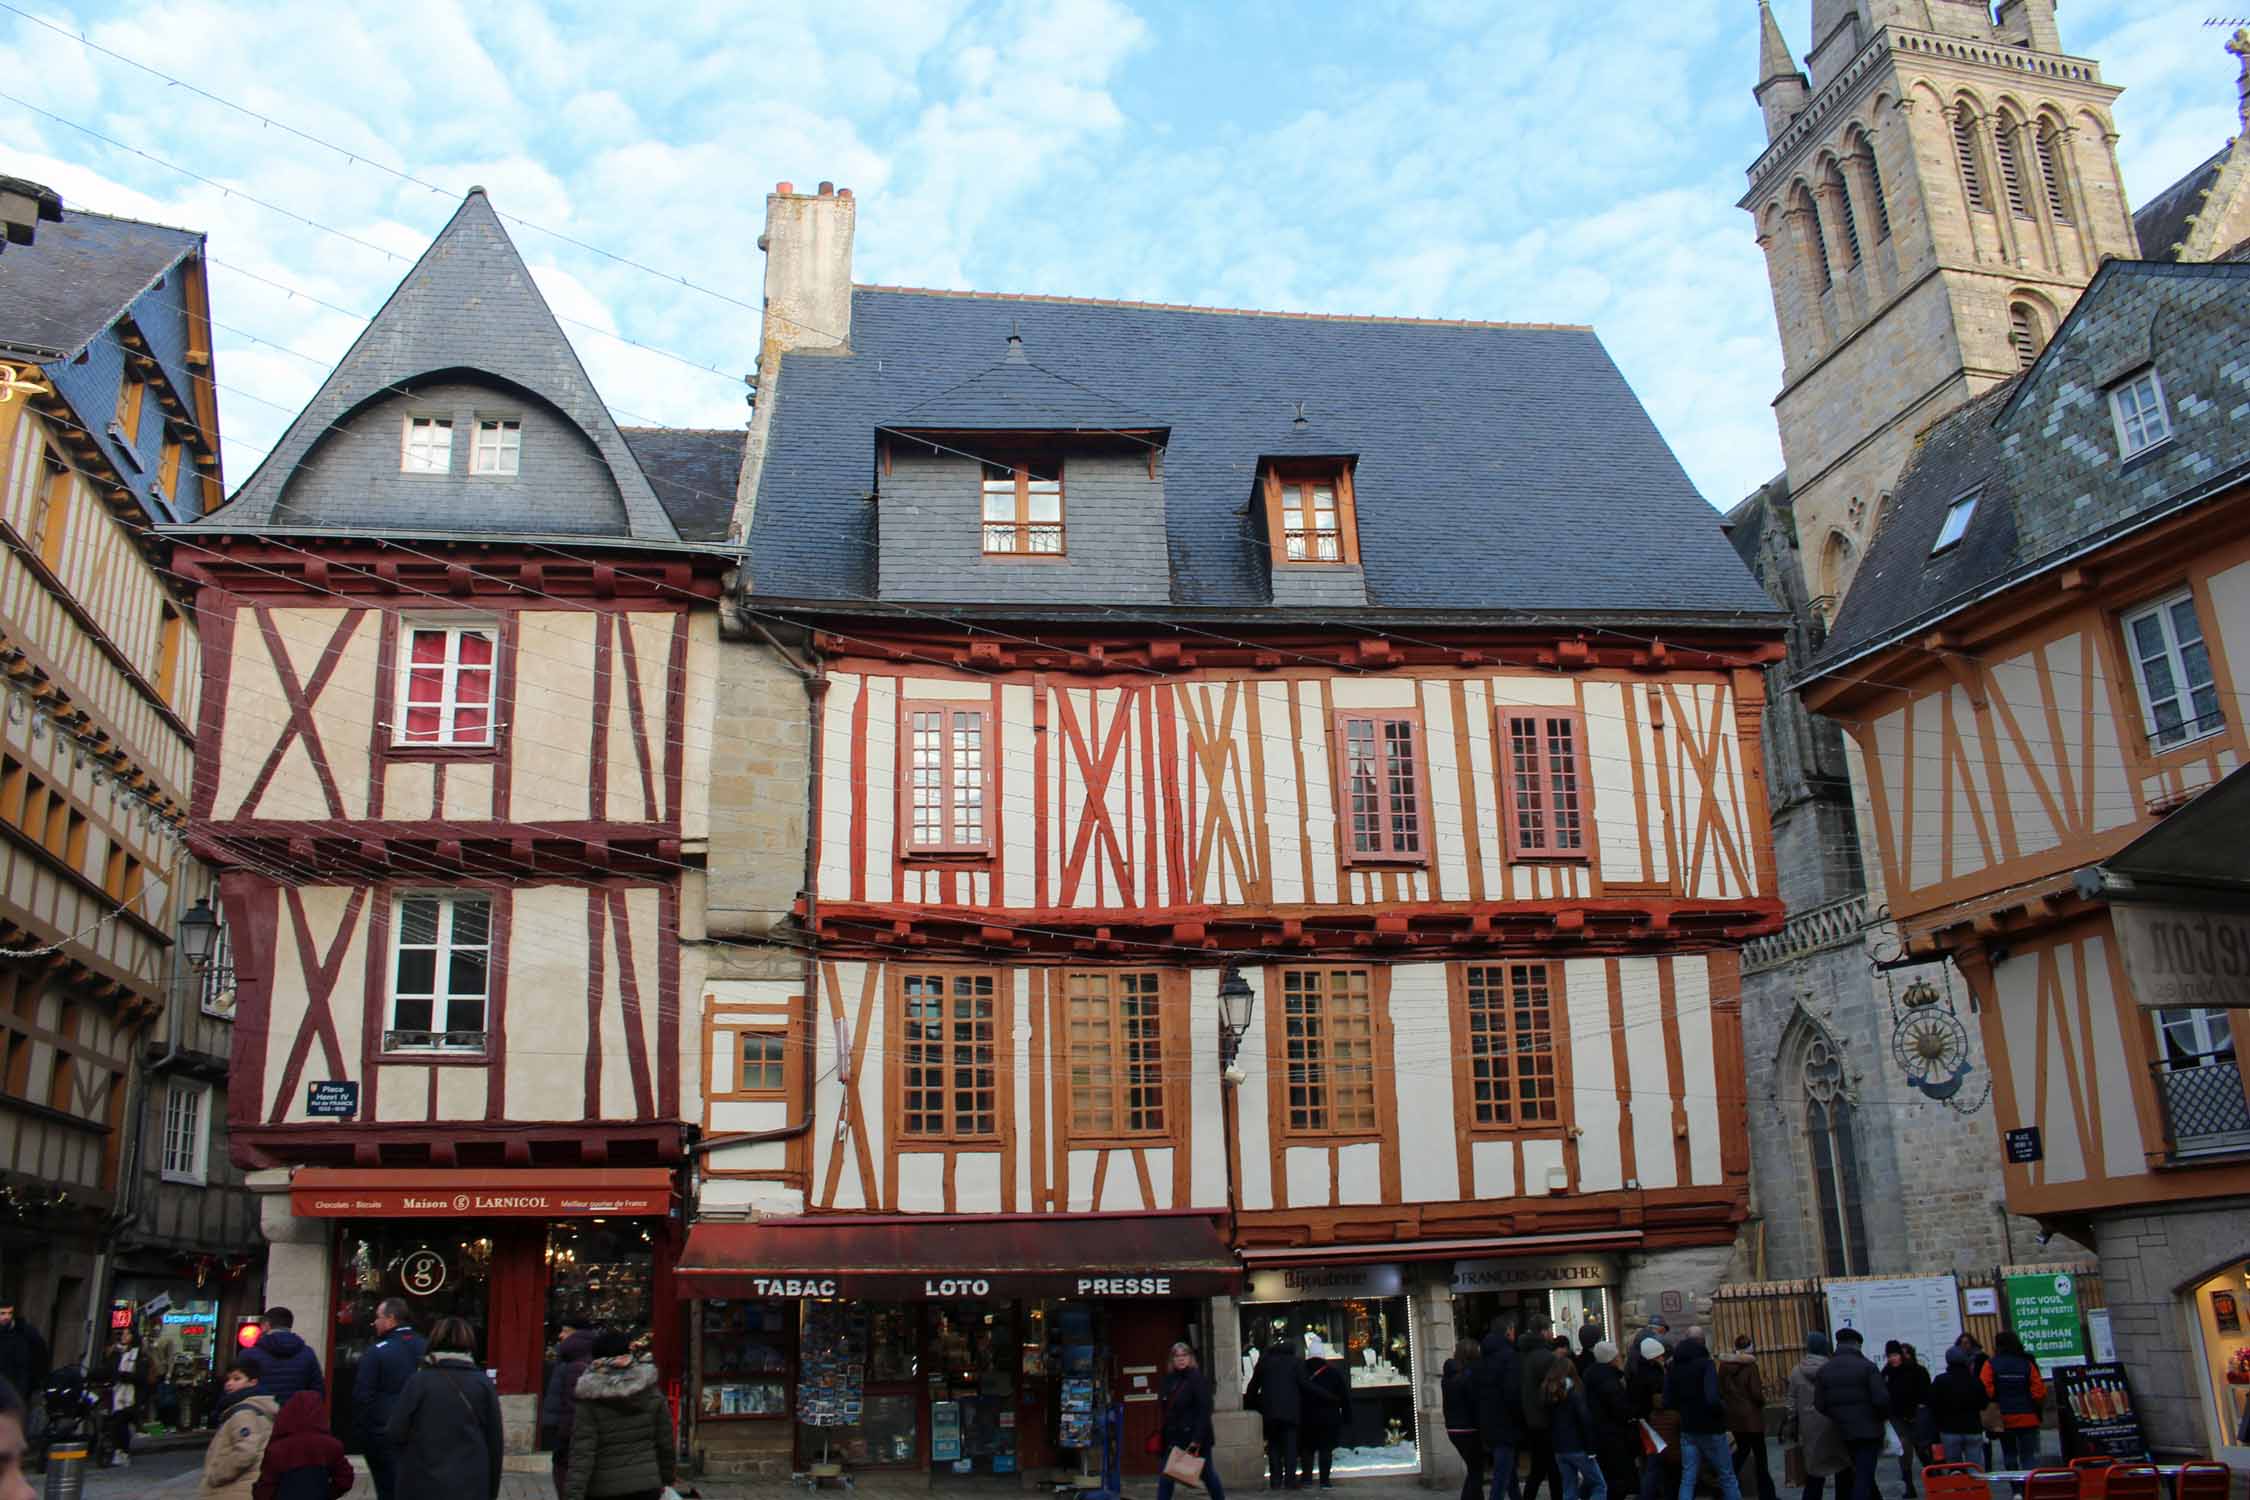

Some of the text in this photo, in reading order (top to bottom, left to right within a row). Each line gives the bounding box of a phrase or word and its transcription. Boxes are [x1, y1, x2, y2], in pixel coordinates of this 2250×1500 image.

[315, 1201, 349, 1209] Chocolats
[356, 1201, 383, 1209] Biscuits
[403, 1198, 448, 1209] Maison
[475, 1196, 550, 1208] LARNICOL
[624, 1199, 648, 1207] France
[753, 1280, 836, 1297] TABAC
[926, 1279, 990, 1296] LOTO
[1077, 1278, 1171, 1295] PRESSE
[2016, 1295, 2064, 1305] AVEC VOUS,
[2018, 1316, 2049, 1329] pour le
[2020, 1328, 2073, 1340] MORBIHAN
[2024, 1337, 2074, 1352] de demain
